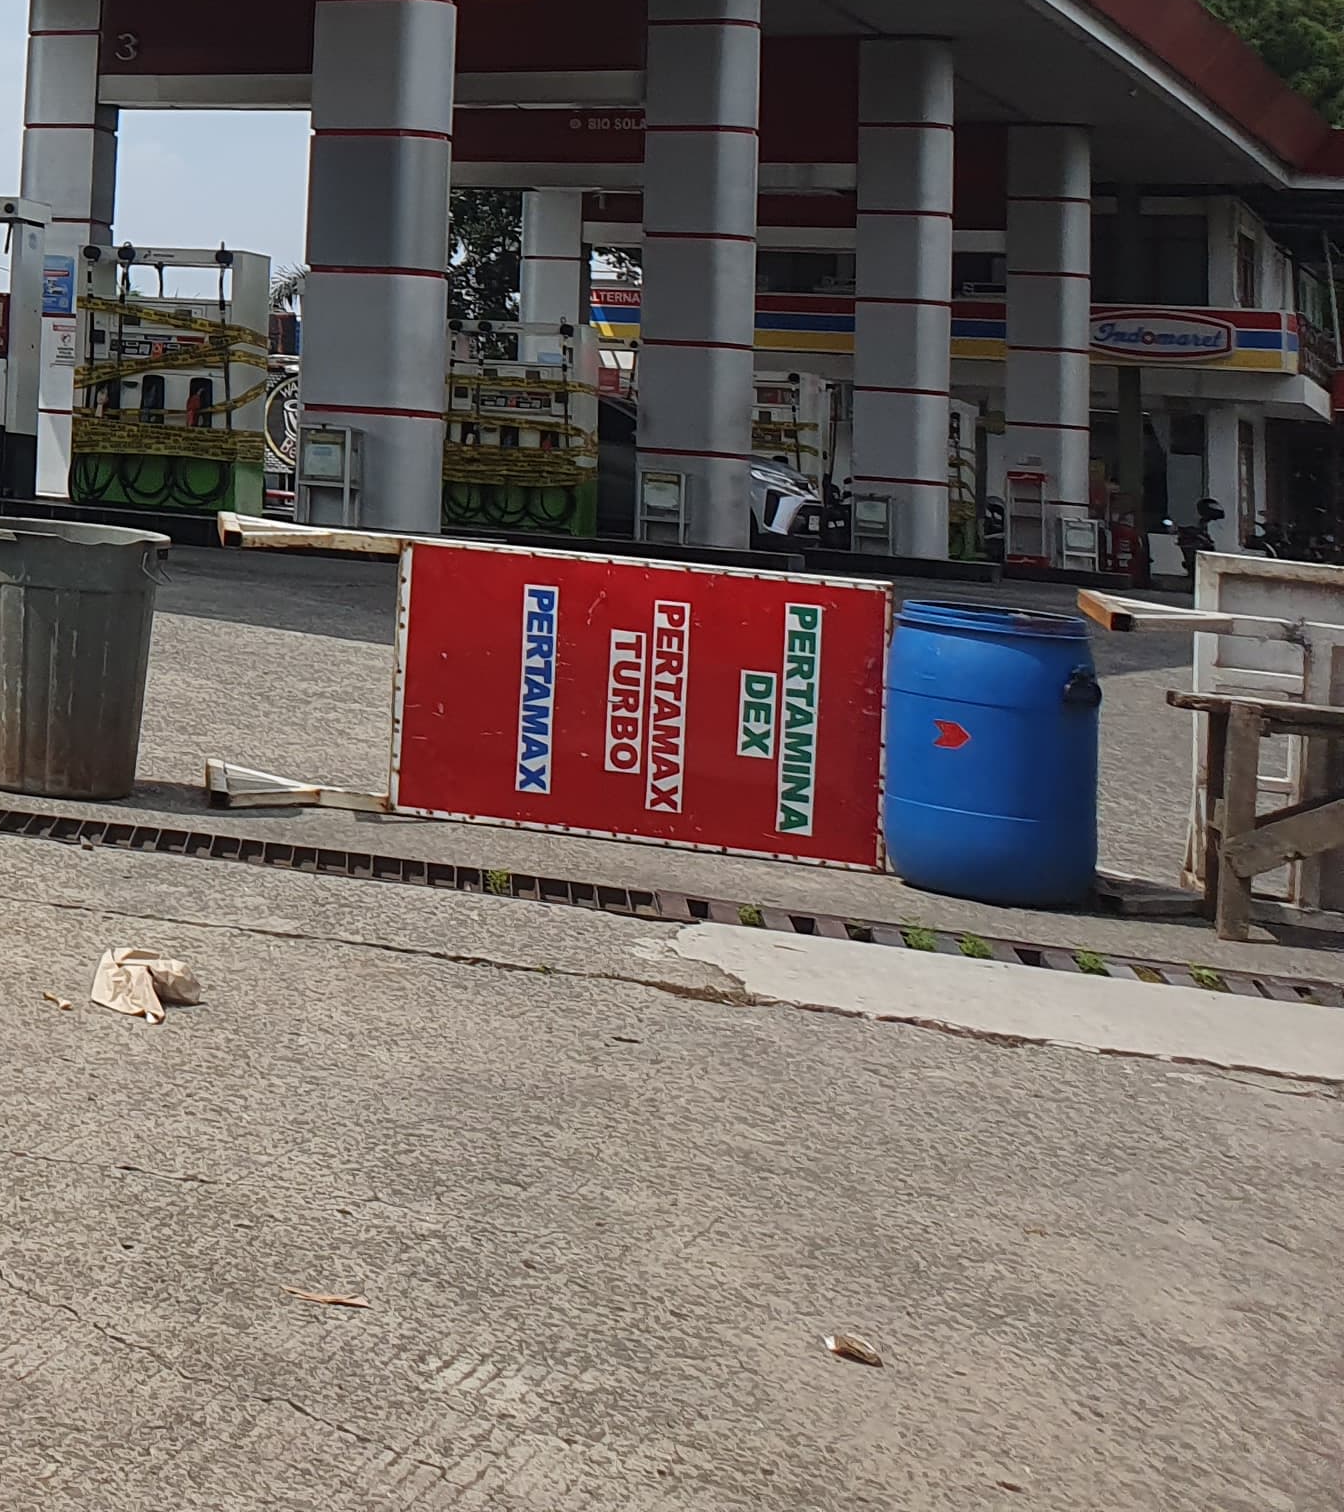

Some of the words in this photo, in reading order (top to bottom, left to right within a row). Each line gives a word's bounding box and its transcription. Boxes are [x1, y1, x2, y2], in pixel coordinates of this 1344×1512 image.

[115, 33, 138, 61] 3
[614, 118, 648, 130] SOLA
[519, 588, 555, 791] PERTAMAX
[609, 635, 643, 770] TURBO
[650, 604, 685, 809] PERTAMAX
[741, 673, 775, 755] DEX
[778, 606, 819, 832] PERTAMINA
